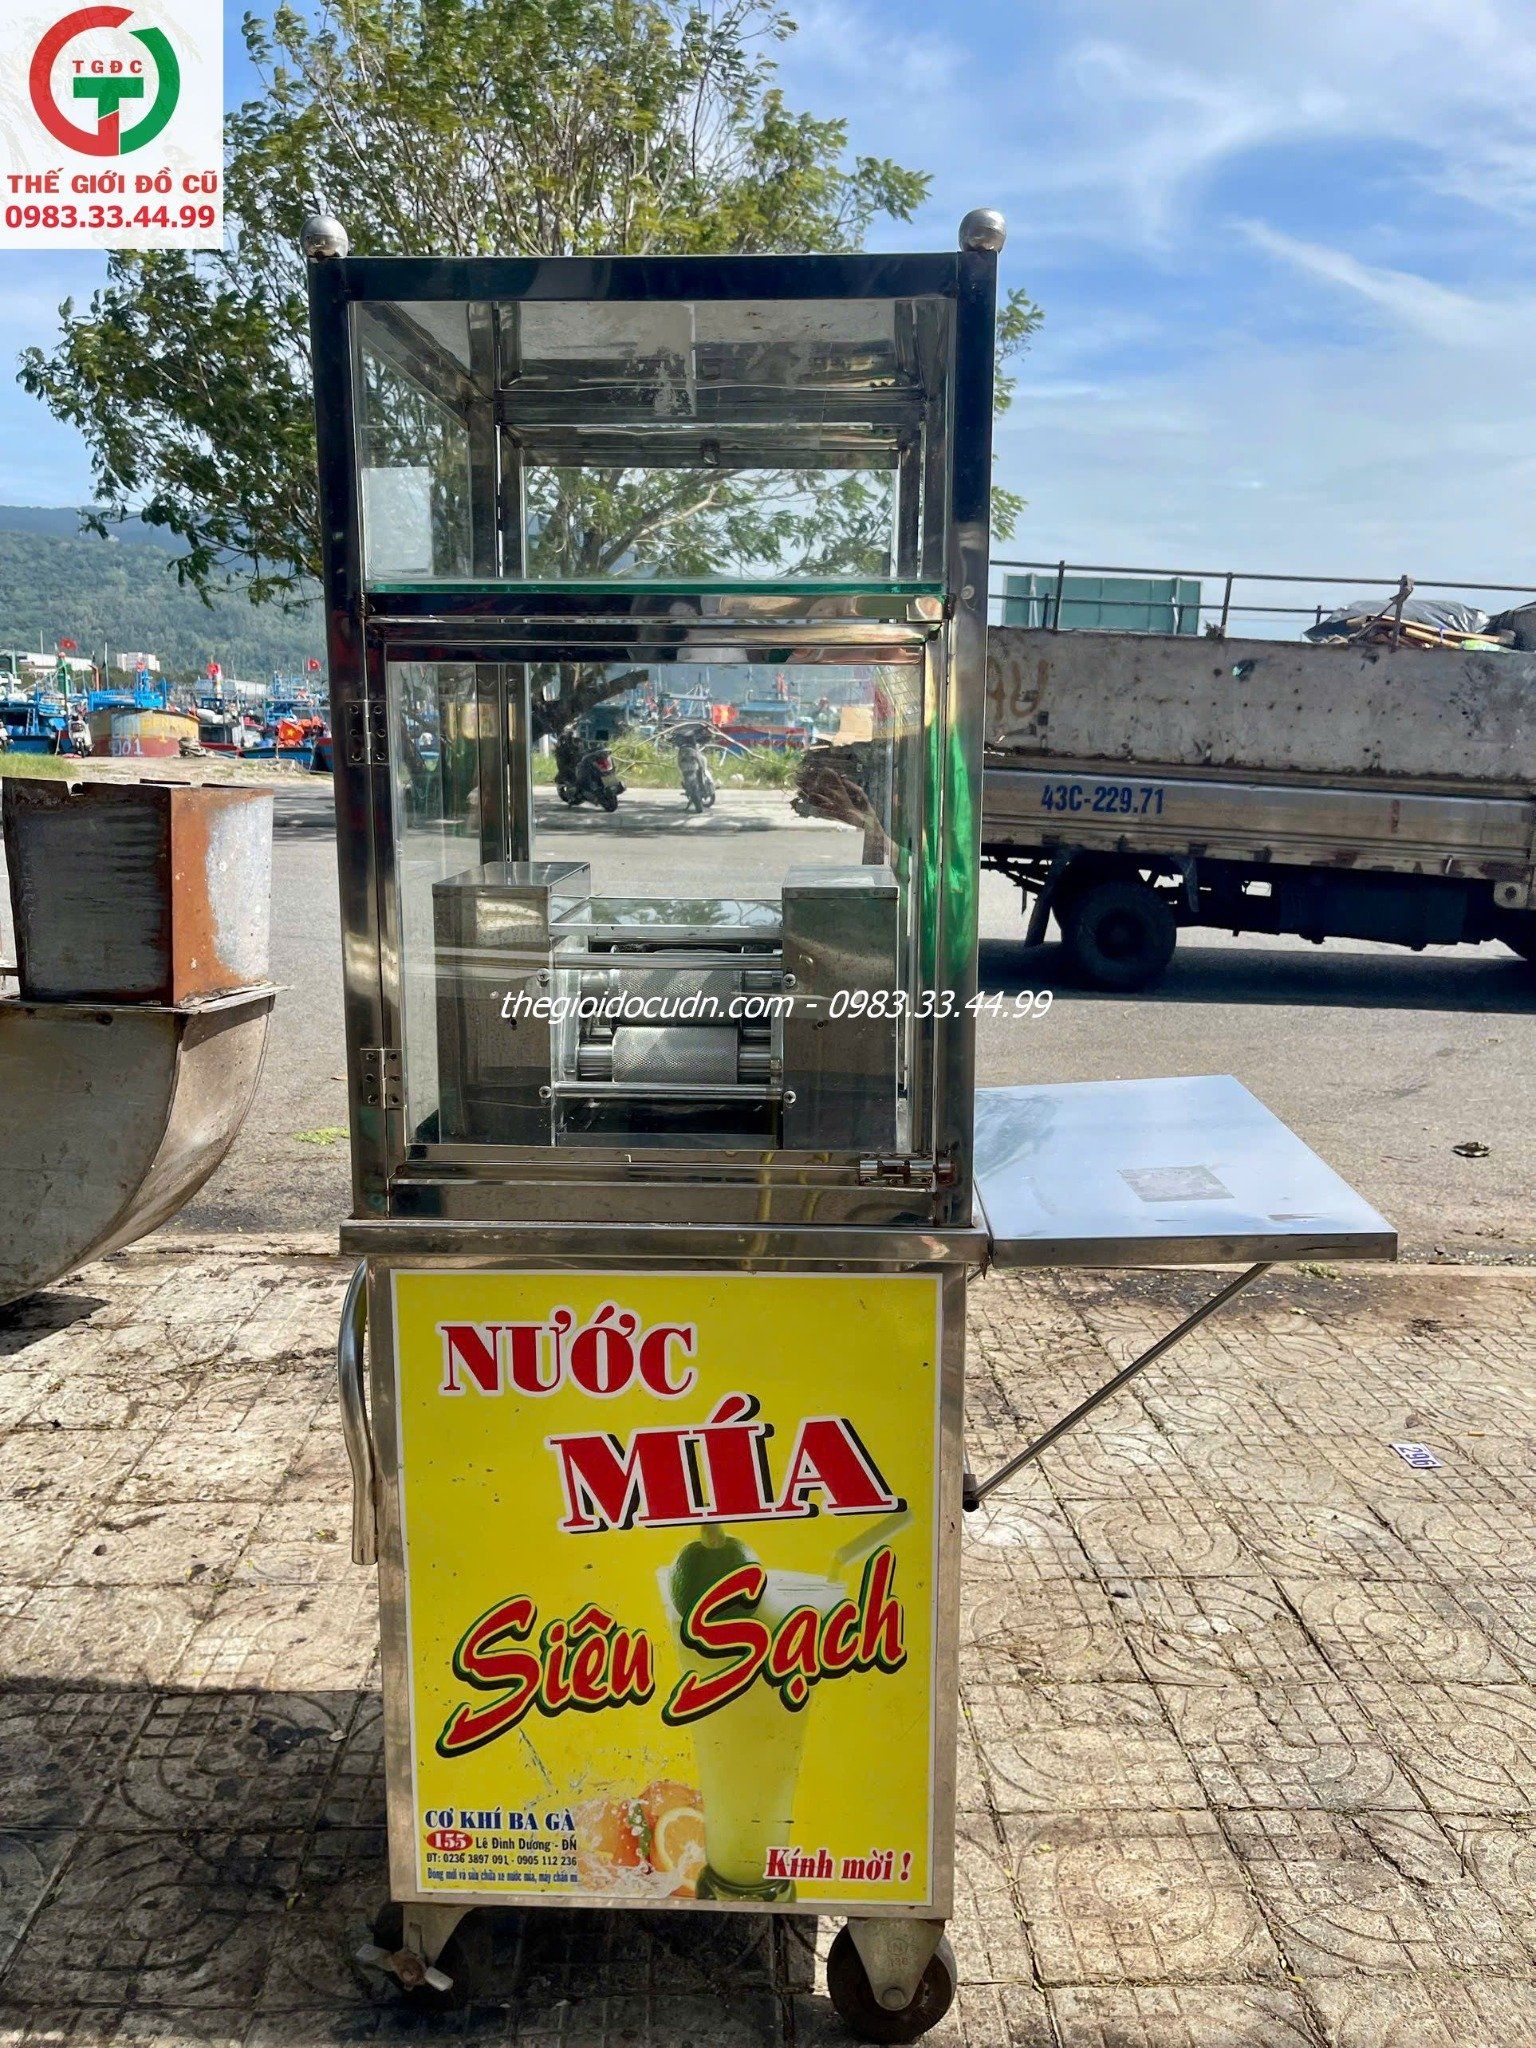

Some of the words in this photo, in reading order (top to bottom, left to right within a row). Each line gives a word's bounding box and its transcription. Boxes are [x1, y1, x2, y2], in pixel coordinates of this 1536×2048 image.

[1041, 784, 1165, 814] 43C-229.71
[438, 1303, 697, 1398] NƯỚC
[546, 1393, 903, 1532] MÍA
[437, 1594, 655, 1757] Siêu
[662, 1544, 906, 1726] Sạch
[425, 1807, 454, 1829] CƠ
[460, 1806, 502, 1830] KHÍ
[545, 1808, 576, 1832] GÀ
[434, 1831, 468, 1850] 155
[475, 1837, 488, 1850] Lê
[443, 1852, 466, 1864] 0236
[468, 1853, 490, 1865] 3897
[492, 1854, 510, 1867] 091
[516, 1855, 539, 1867] 0905
[542, 1856, 558, 1867] 112
[560, 1856, 578, 1867] 236
[764, 1847, 834, 1880] Kính
[840, 1848, 894, 1882] mời
